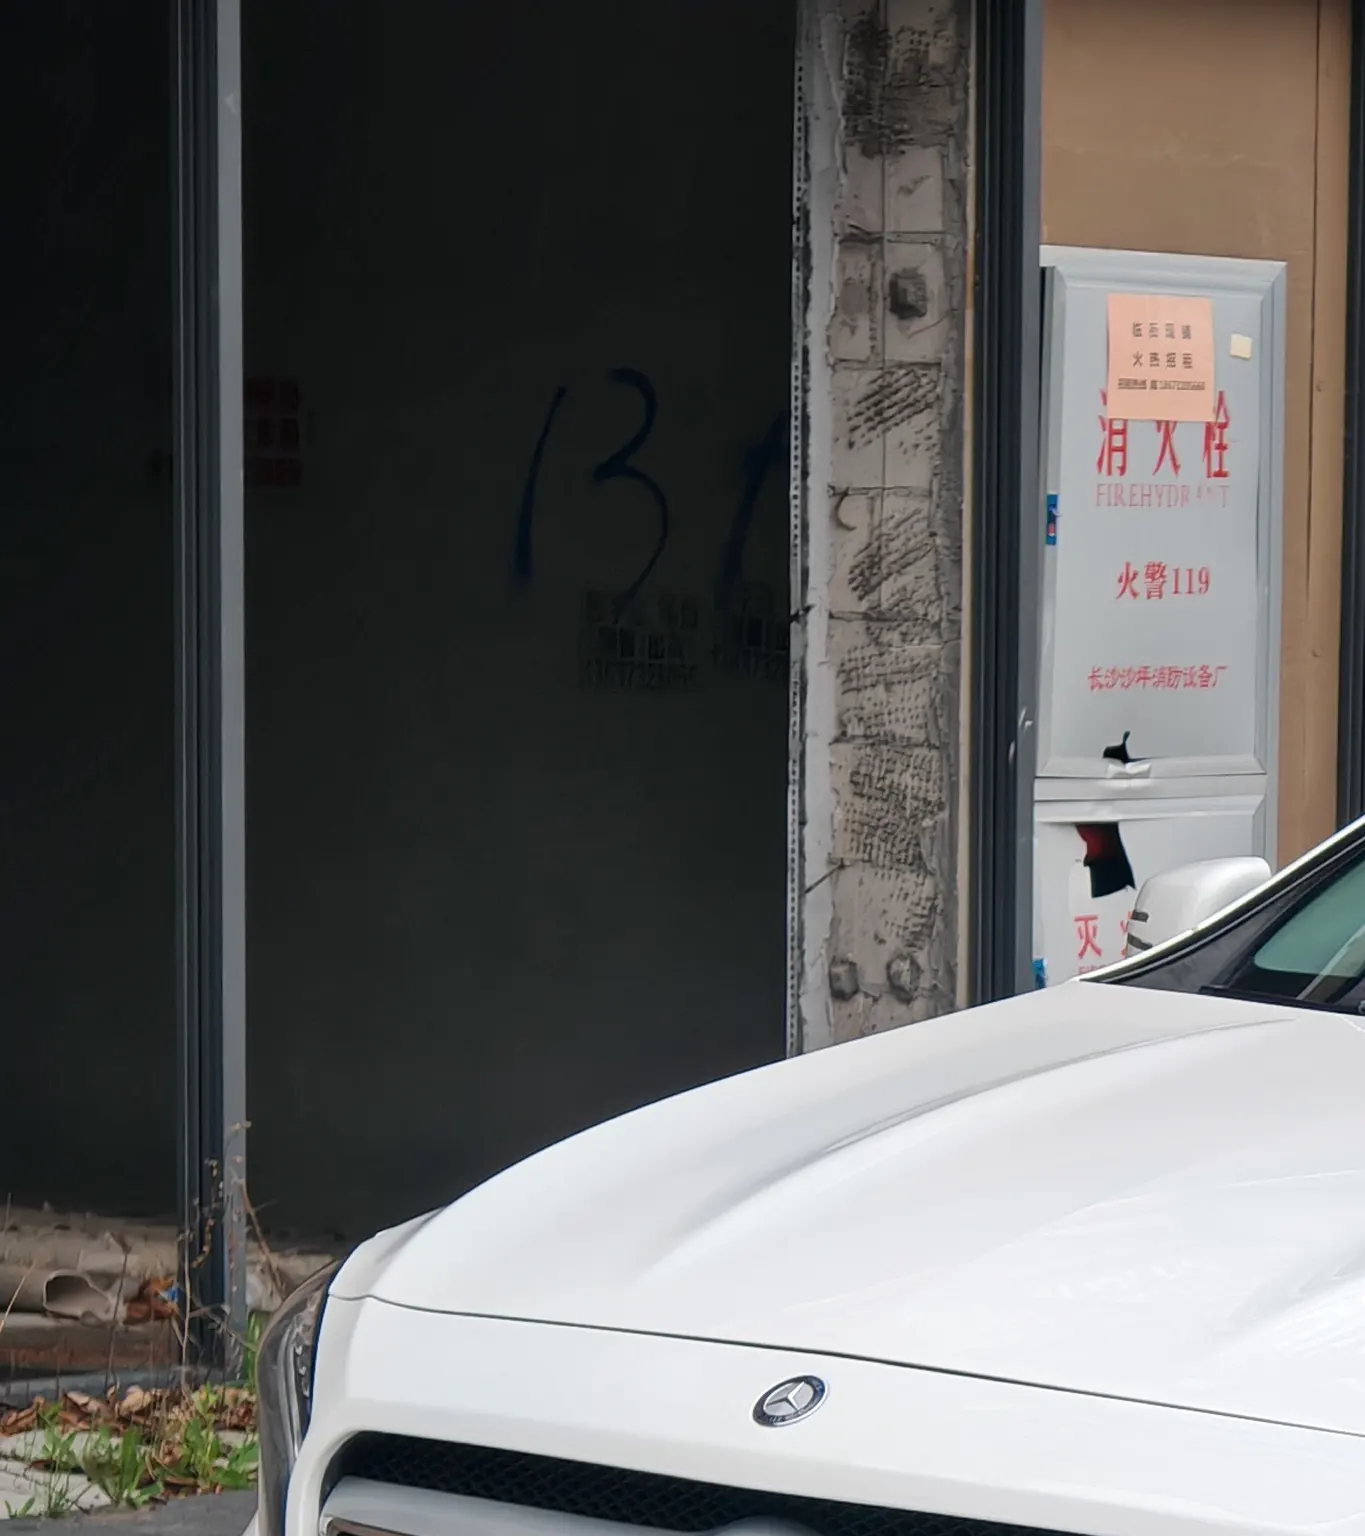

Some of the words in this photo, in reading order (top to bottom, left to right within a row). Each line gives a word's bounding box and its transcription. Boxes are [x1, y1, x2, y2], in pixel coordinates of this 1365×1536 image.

[1096, 389, 1231, 479] 消火栓
[1116, 561, 1211, 600] 火警119
